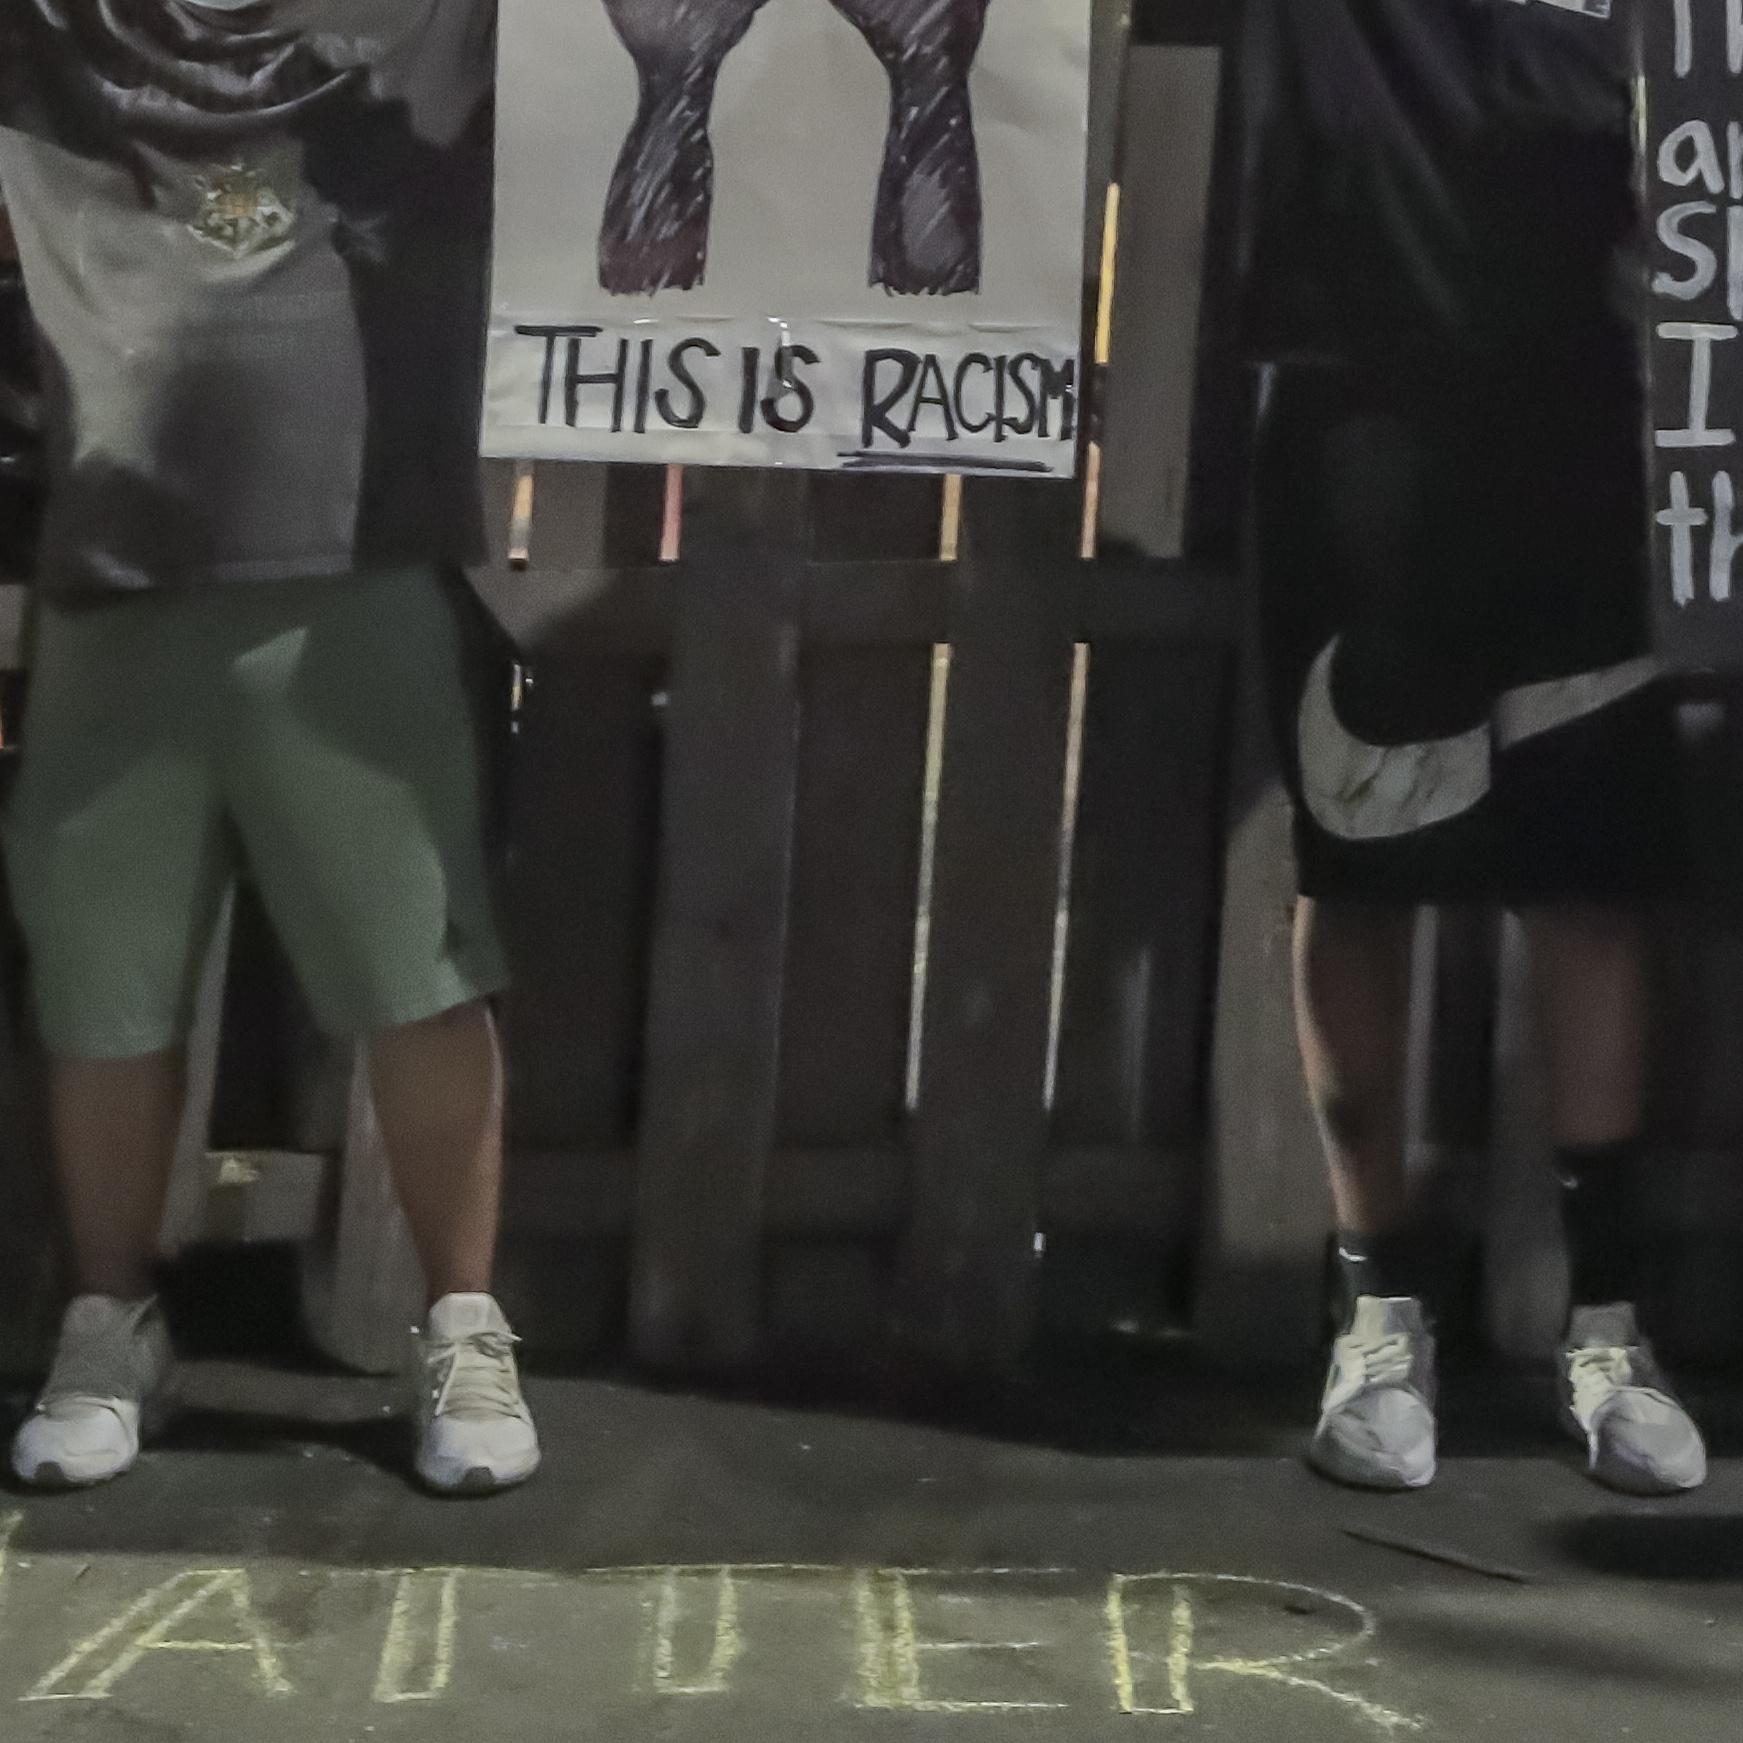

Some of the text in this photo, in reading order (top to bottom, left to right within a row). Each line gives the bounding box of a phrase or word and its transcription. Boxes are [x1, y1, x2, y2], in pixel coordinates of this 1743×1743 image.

[514, 325, 1076, 449] THIS IS RACISM
[1654, 322, 1738, 447] I
